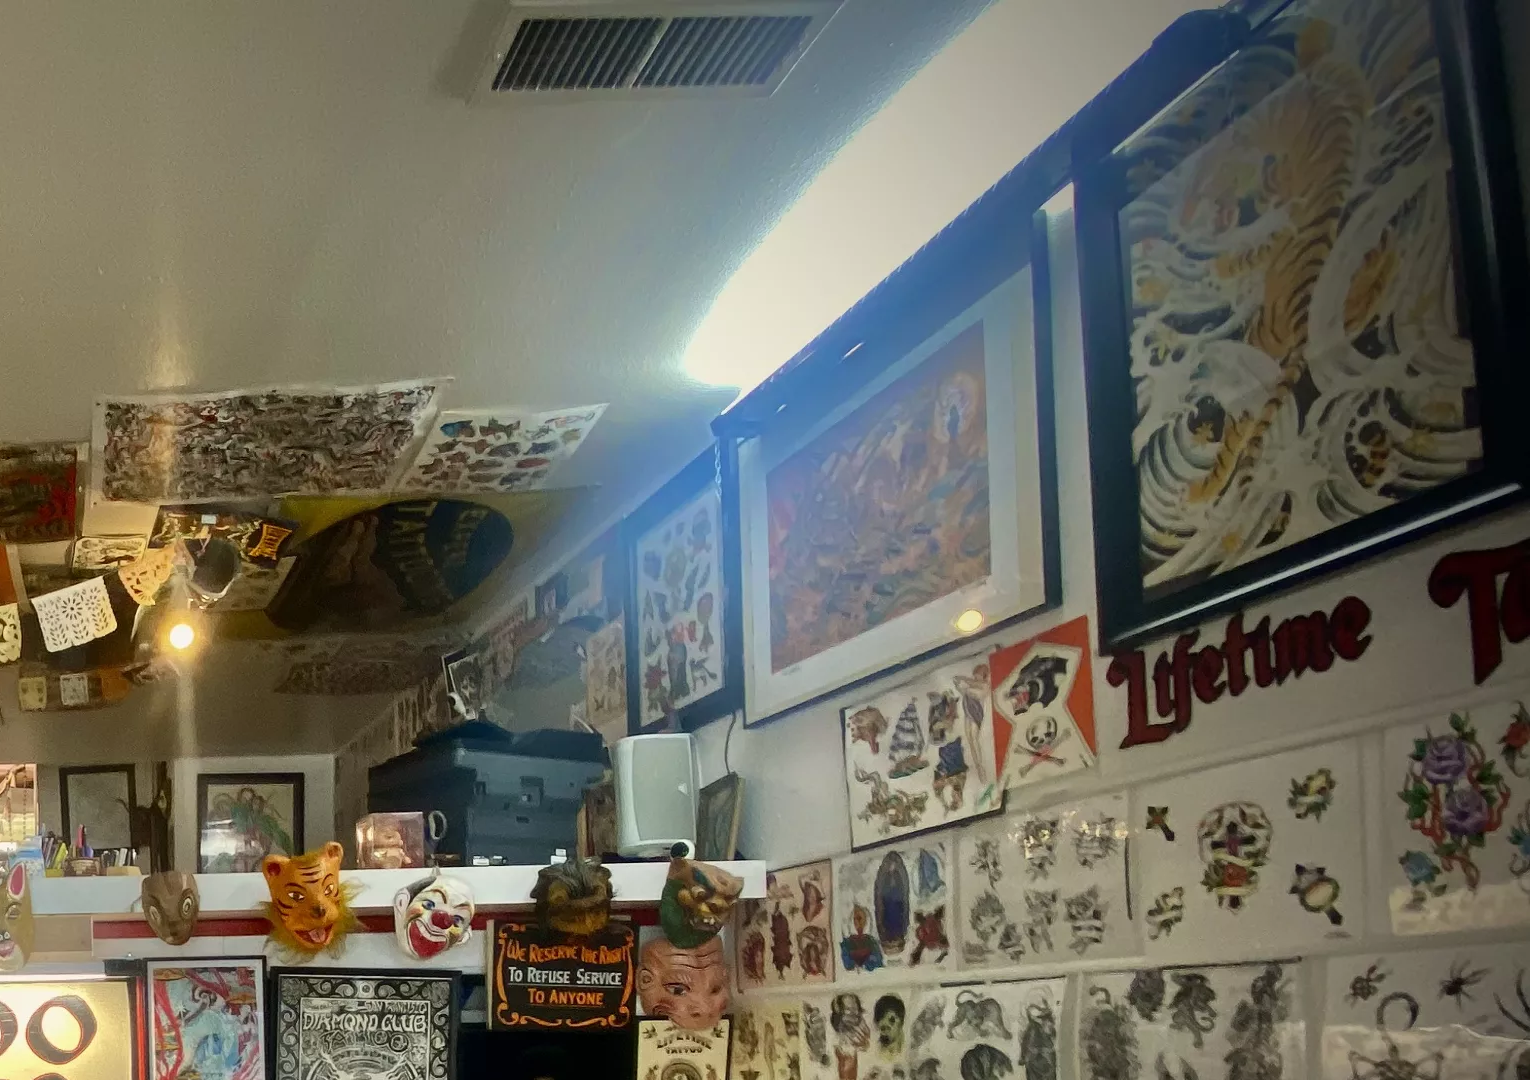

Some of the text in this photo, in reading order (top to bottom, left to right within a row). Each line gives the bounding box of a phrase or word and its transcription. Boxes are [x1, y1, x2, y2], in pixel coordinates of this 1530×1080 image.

[1106, 595, 1373, 750] Lifetime
[529, 944, 577, 963] RESERVE
[599, 945, 627, 965] RIGHT
[509, 966, 622, 985] TO REFUSE SERVICE
[528, 988, 603, 1005] TO ANYONE
[302, 1013, 427, 1033] DIAMOND CLUB
